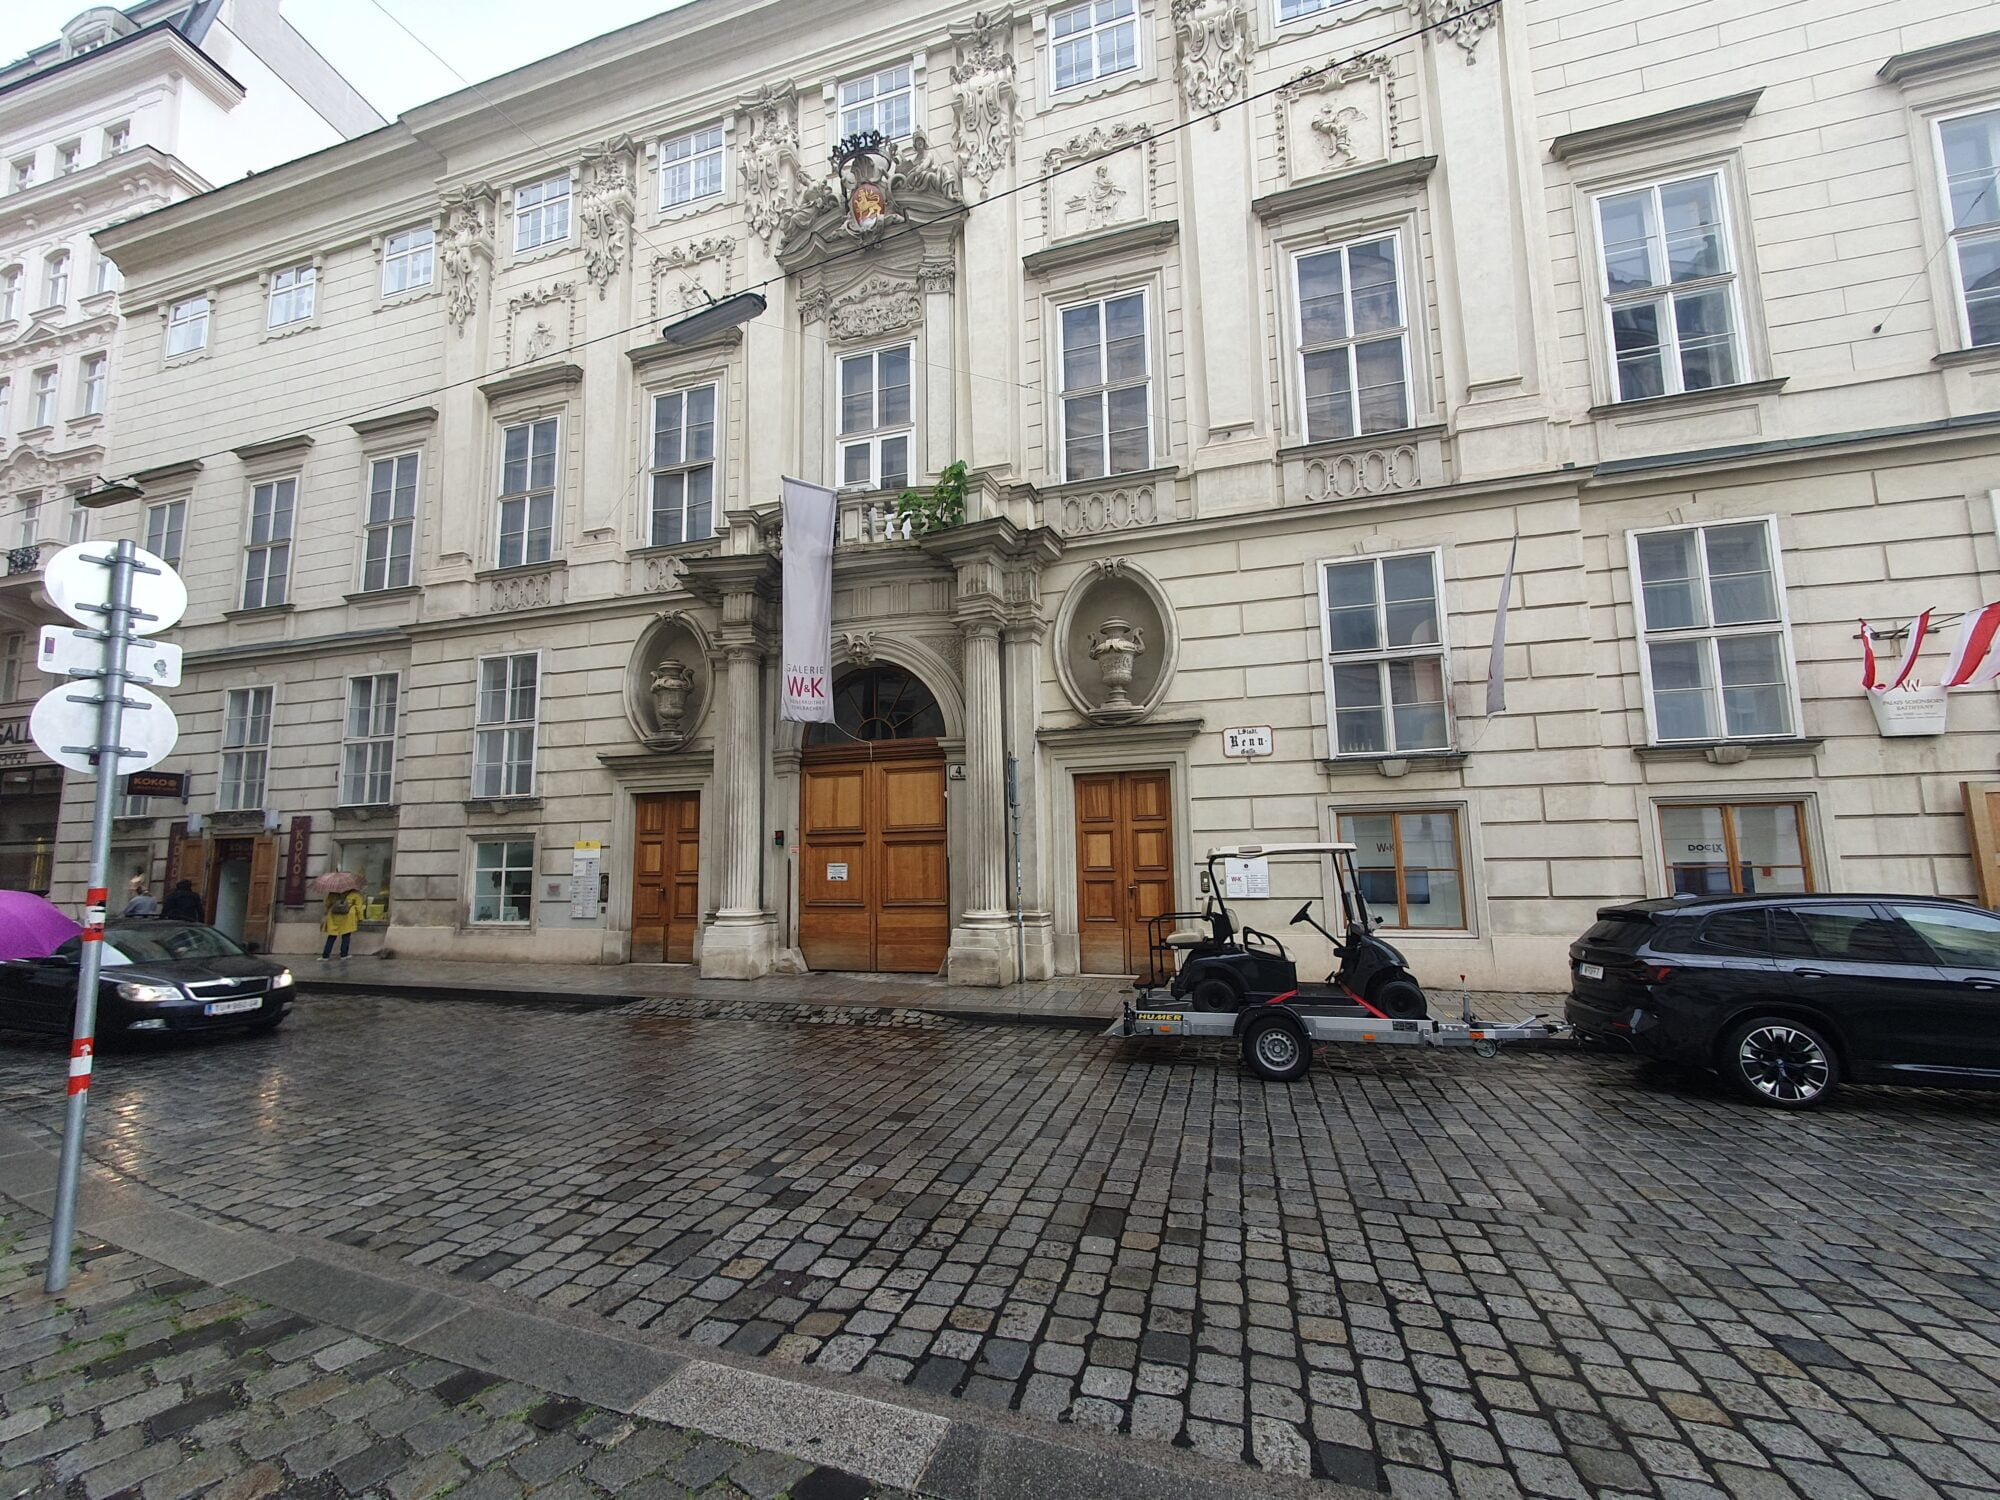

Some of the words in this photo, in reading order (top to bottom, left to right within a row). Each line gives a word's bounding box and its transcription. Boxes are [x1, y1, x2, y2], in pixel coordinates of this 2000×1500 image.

[784, 663, 824, 675] GALERIE
[786, 675, 824, 698] W&K
[955, 765, 962, 776] 4
[133, 776, 168, 787] KOKO
[293, 829, 304, 875] KOKO
[1138, 1013, 1182, 1021] HUMER
